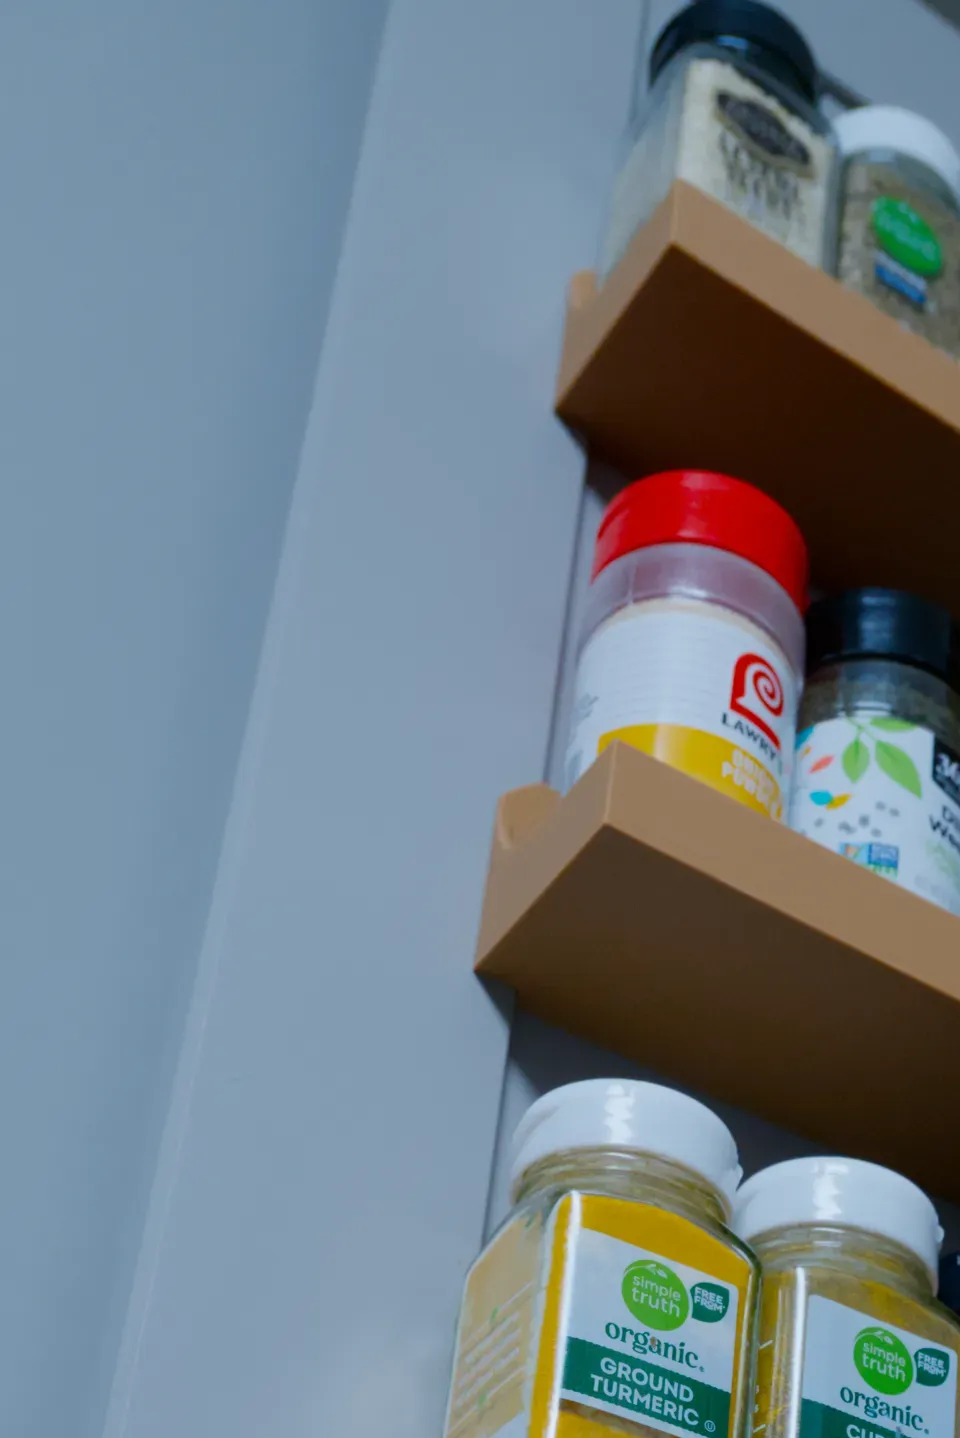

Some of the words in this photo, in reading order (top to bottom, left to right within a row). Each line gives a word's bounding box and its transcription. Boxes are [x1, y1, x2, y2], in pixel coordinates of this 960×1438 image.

[721, 712, 777, 762] LAWRY
[632, 1275, 681, 1300] simple
[632, 1287, 681, 1318] truth
[694, 1286, 723, 1305] FREE
[862, 1341, 906, 1366] simple
[862, 1352, 906, 1383] truth
[917, 1352, 944, 1369] FREE
[600, 1357, 694, 1403] GROUND
[590, 1374, 699, 1427] TURMERIC
